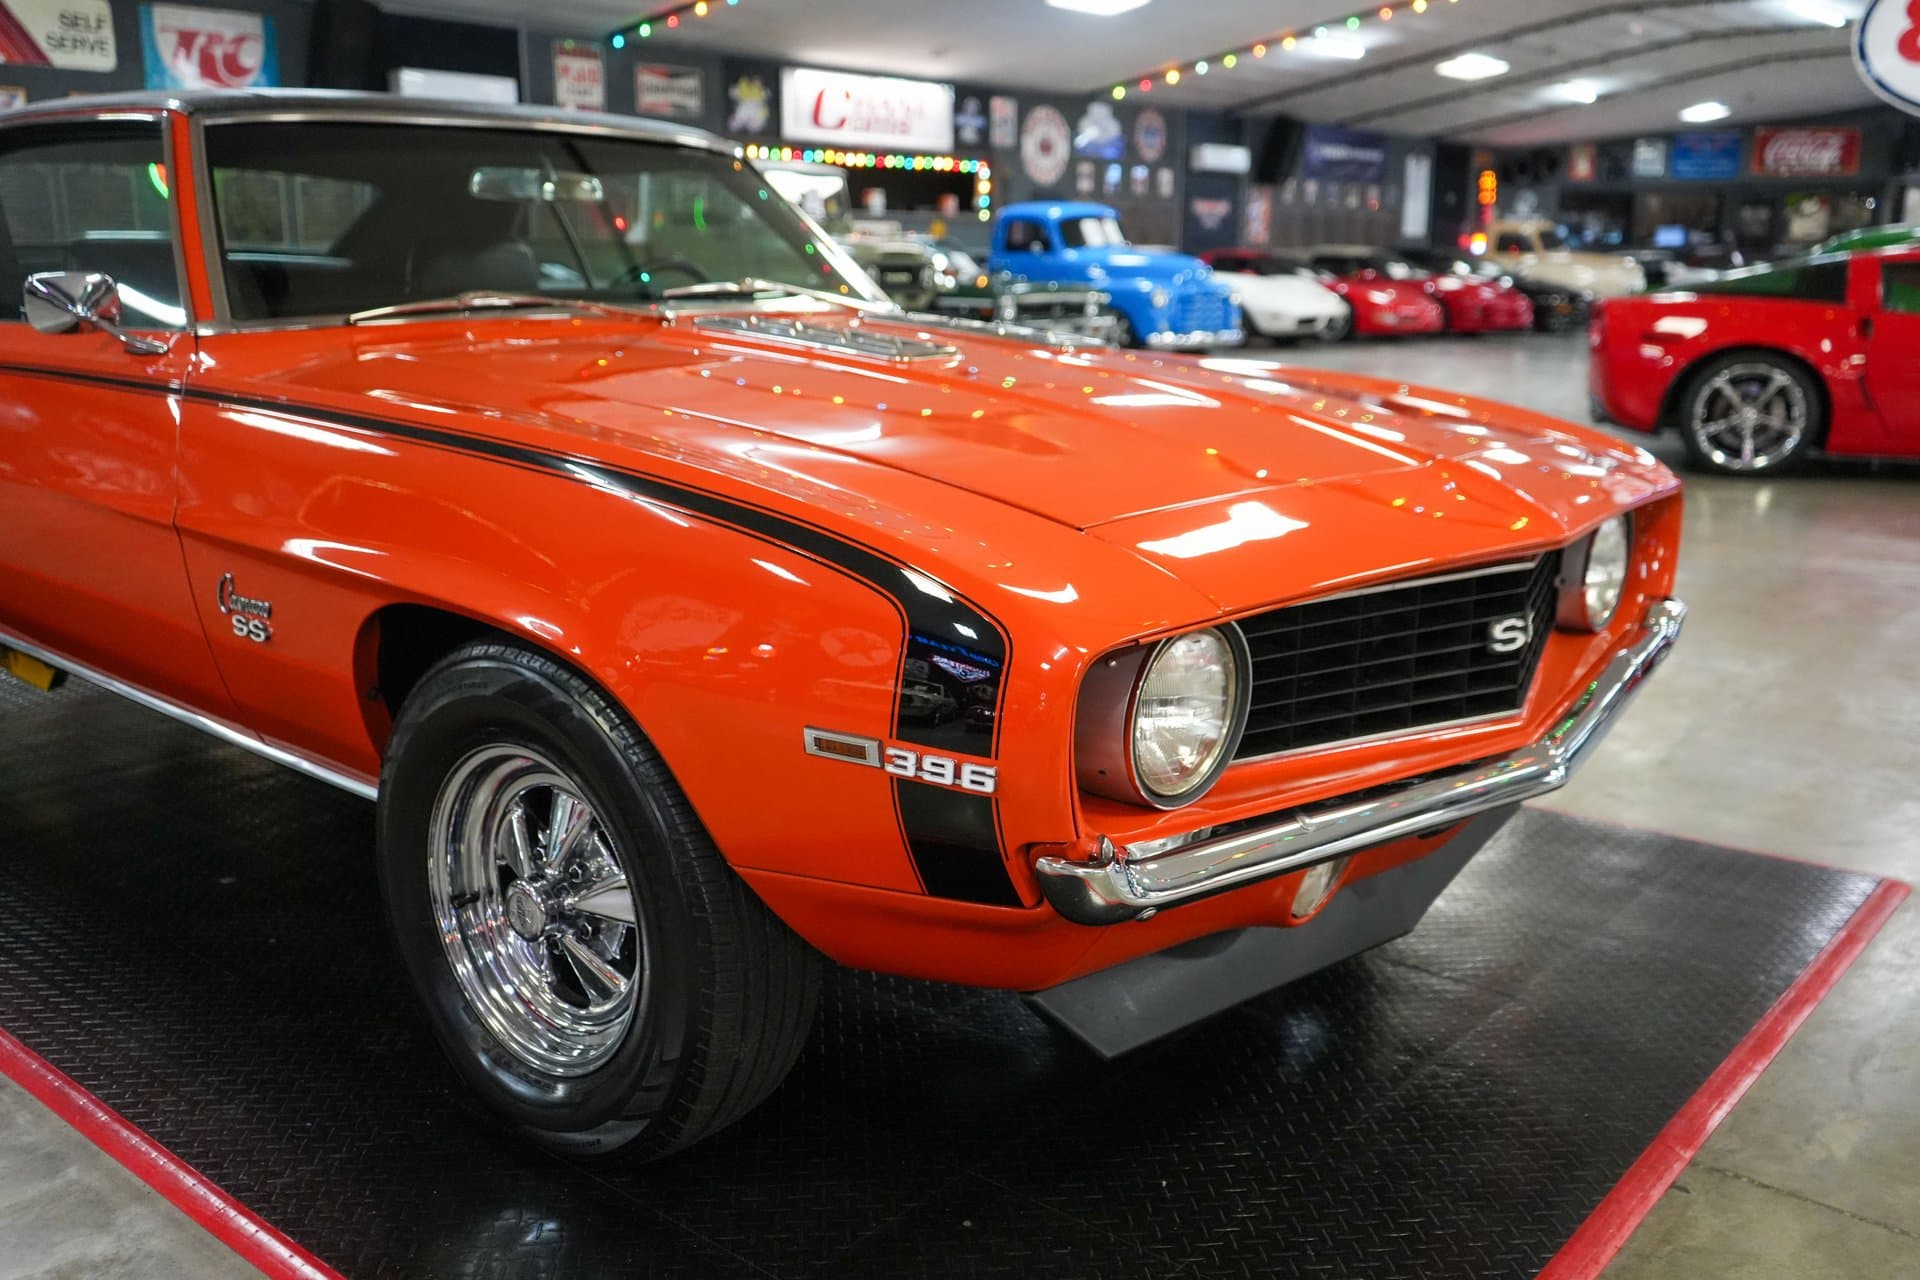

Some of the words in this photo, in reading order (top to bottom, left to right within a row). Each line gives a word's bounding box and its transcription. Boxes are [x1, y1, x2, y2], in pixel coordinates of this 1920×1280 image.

[58, 11, 106, 33] SELF
[46, 32, 109, 57] SERVE
[231, 614, 267, 642] SS
[884, 746, 997, 793] 396
